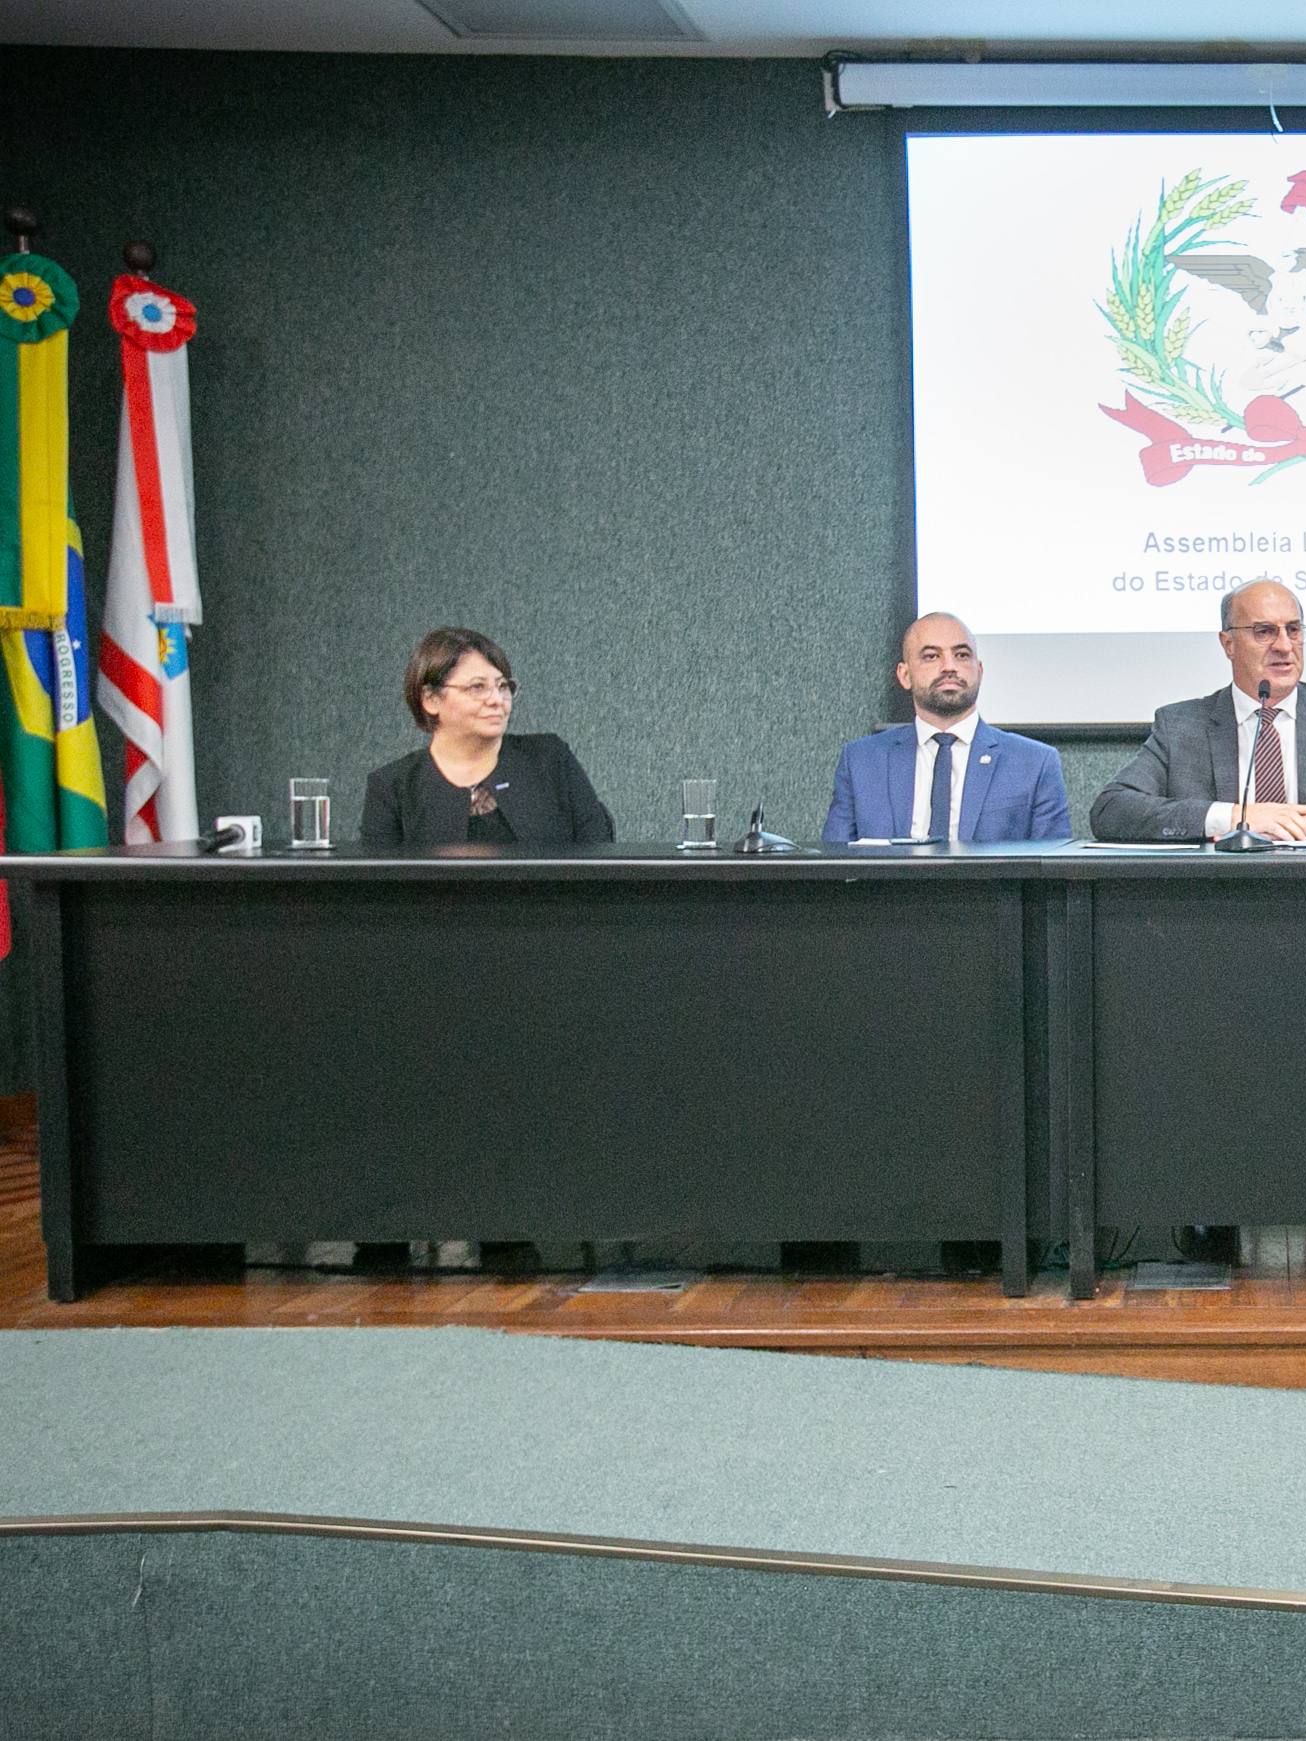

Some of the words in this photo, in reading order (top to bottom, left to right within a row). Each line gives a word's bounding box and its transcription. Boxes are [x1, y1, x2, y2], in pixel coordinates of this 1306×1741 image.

[1169, 443, 1237, 463] Estado
[1143, 531, 1292, 553] Assembleia
[1112, 571, 1145, 592] do
[1155, 571, 1243, 592] Estado
[55, 632, 75, 723] ROGRESSO
